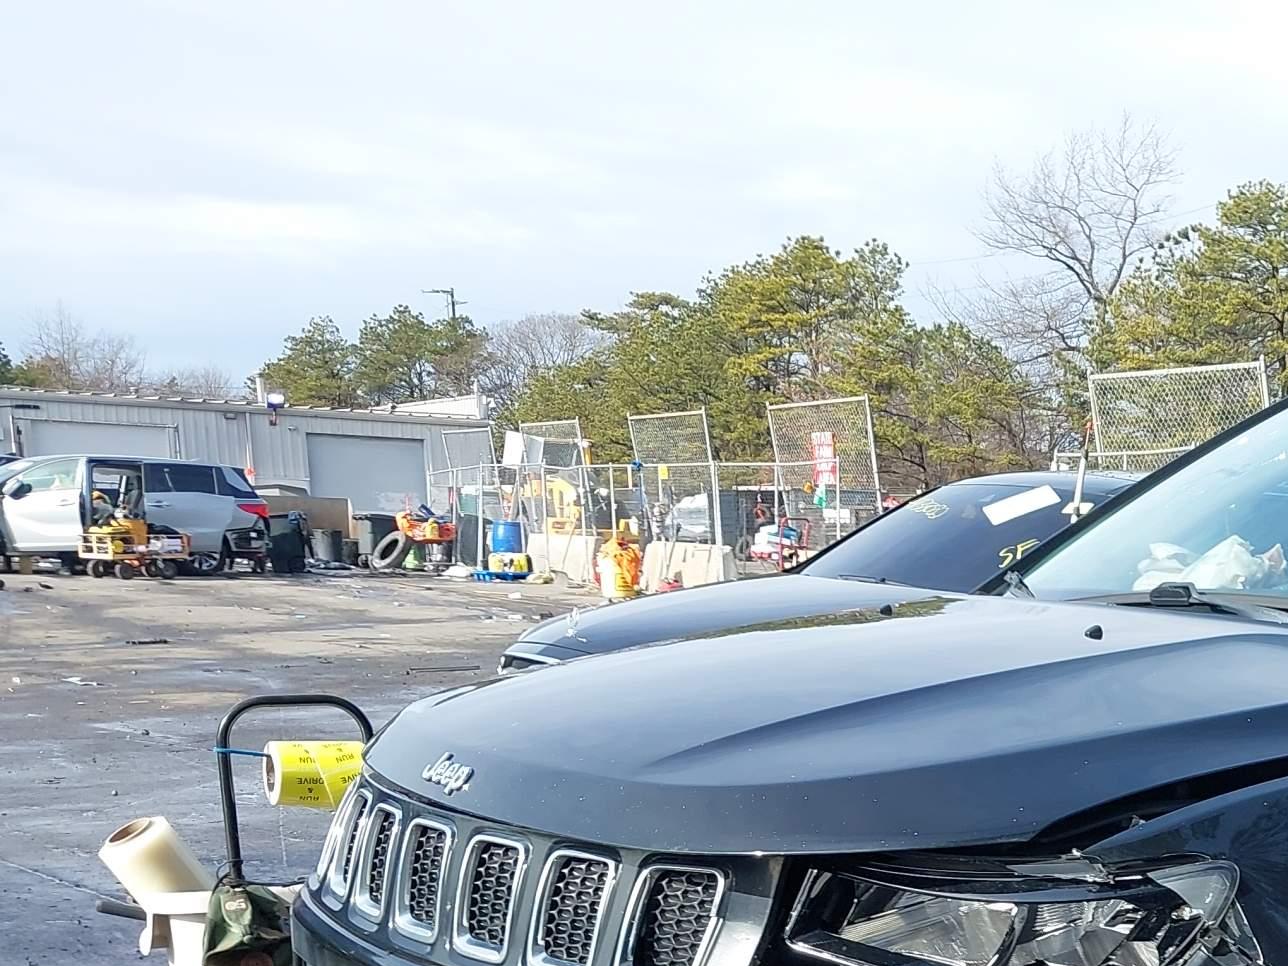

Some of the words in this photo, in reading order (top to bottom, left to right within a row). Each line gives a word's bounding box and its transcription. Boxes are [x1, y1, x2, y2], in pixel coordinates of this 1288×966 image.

[299, 756, 316, 764] UN
[335, 753, 355, 764] RUN
[421, 751, 475, 797] Jeep
[296, 777, 325, 785] DRIVE
